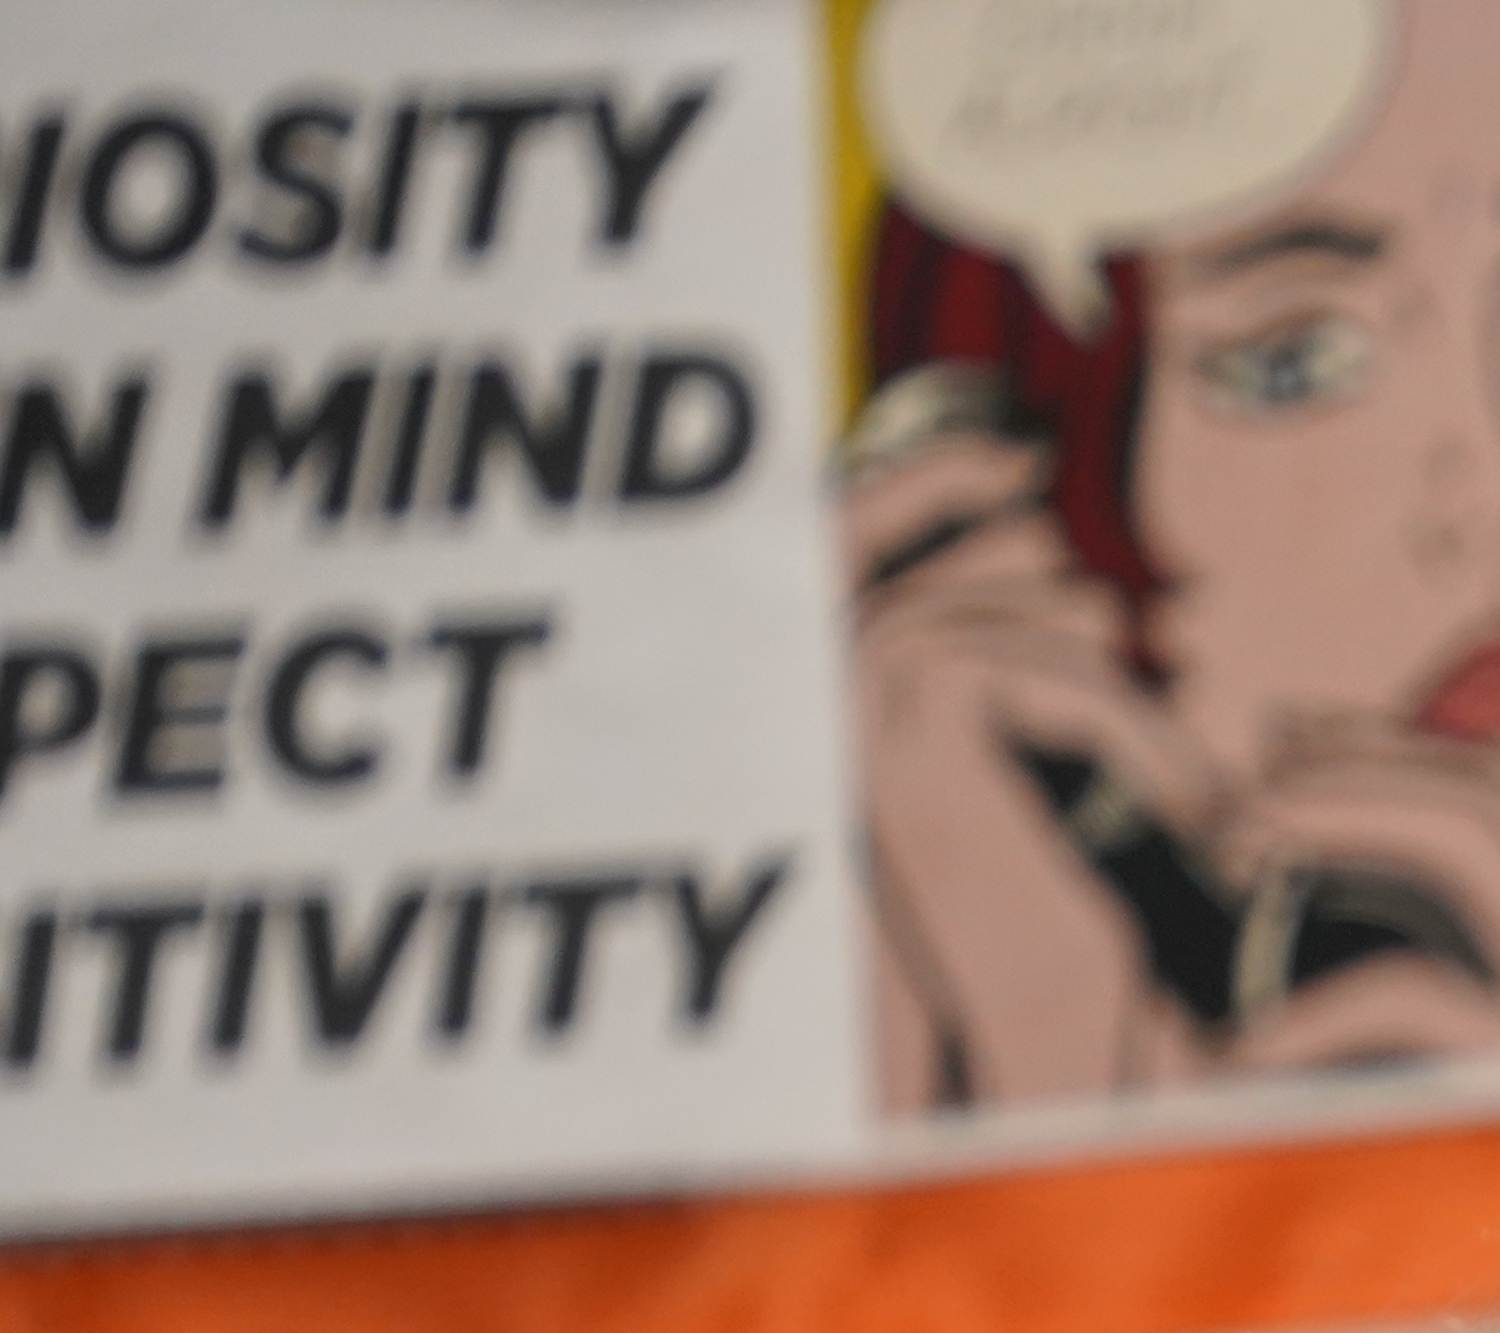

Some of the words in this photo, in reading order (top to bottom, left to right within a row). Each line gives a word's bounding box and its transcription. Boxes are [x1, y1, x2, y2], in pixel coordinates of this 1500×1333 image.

[3, 87, 718, 282] IOSITY
[0, 368, 152, 540] N
[197, 348, 757, 525] MIND
[0, 610, 558, 796] PECT
[2, 860, 788, 1066] ITIVITY
